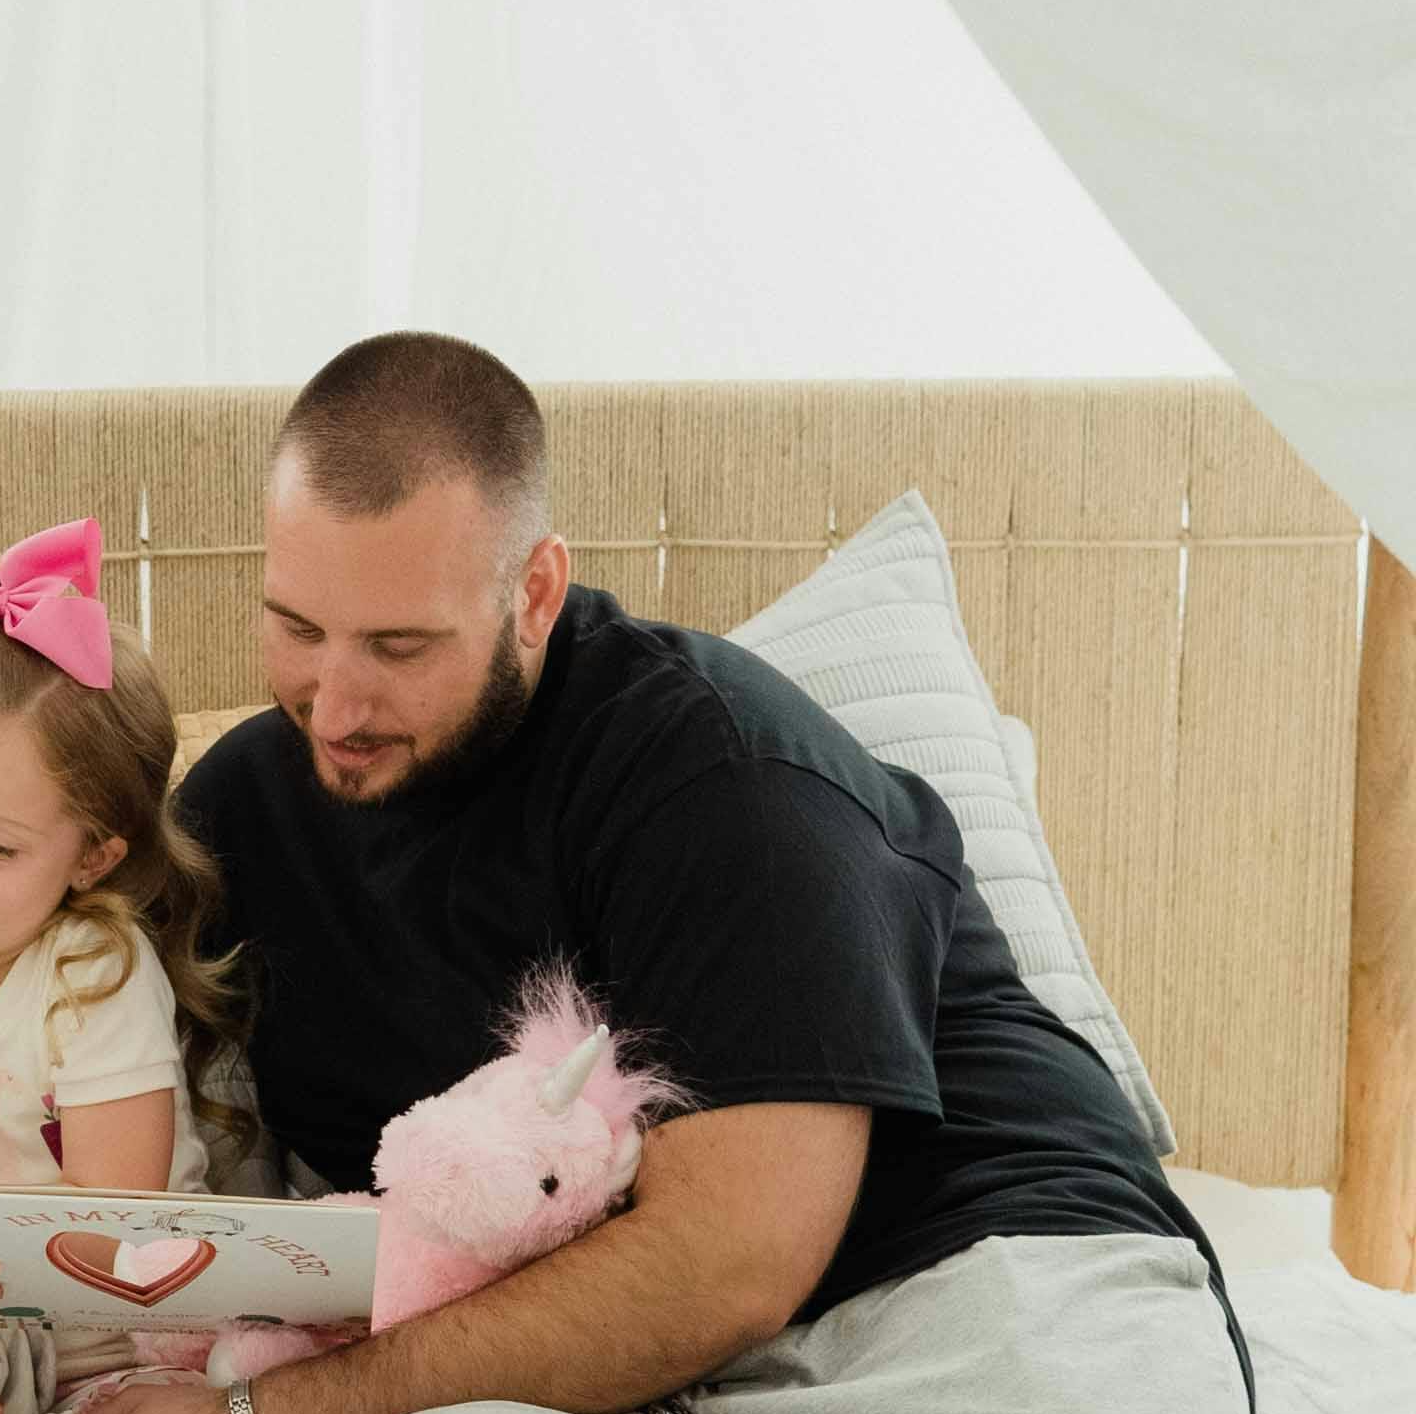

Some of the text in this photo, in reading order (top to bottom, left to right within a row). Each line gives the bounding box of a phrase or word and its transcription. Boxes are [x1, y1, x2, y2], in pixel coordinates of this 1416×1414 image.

[3, 1210, 330, 1277] IN MY HEART
